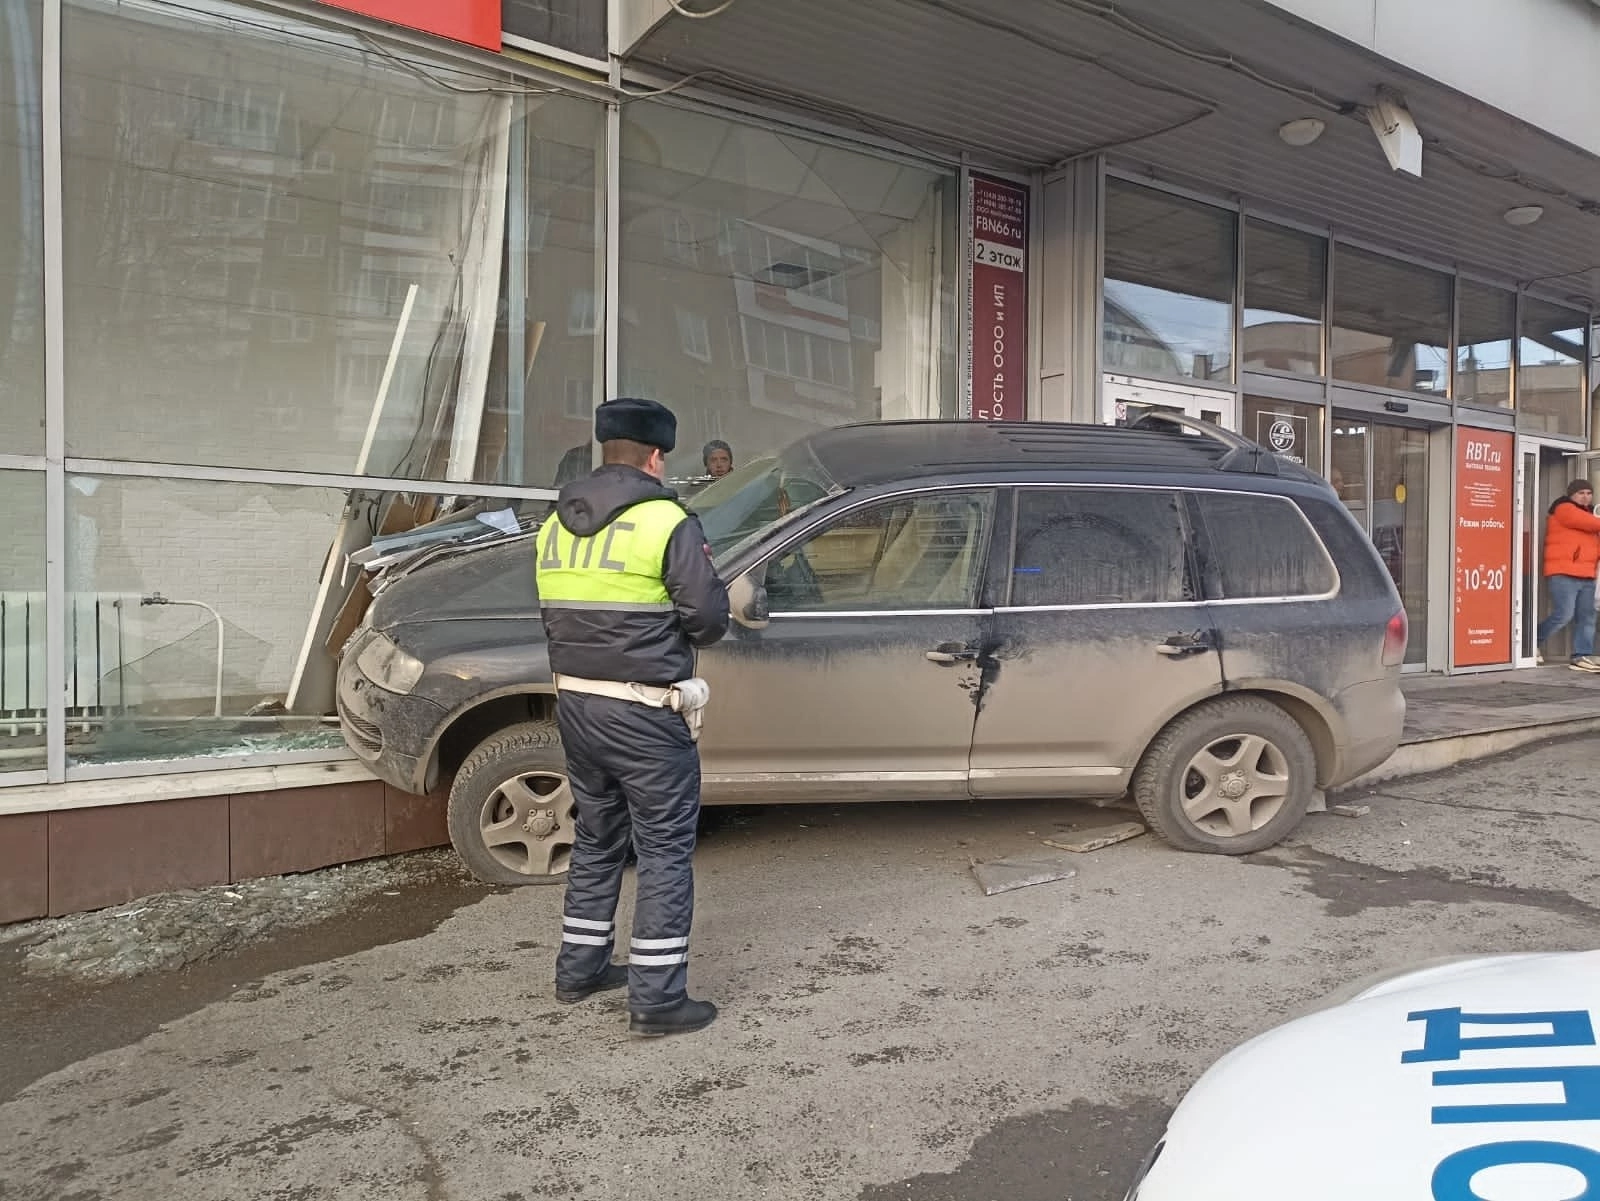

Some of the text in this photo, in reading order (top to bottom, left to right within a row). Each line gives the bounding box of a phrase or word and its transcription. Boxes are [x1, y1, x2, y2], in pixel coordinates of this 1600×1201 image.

[976, 242, 1021, 269] 2 этаж
[993, 284, 1005, 420] ОСТЬ ООО и ИП
[1465, 440, 1501, 463] RBT.ru
[541, 521, 636, 571] ДПС
